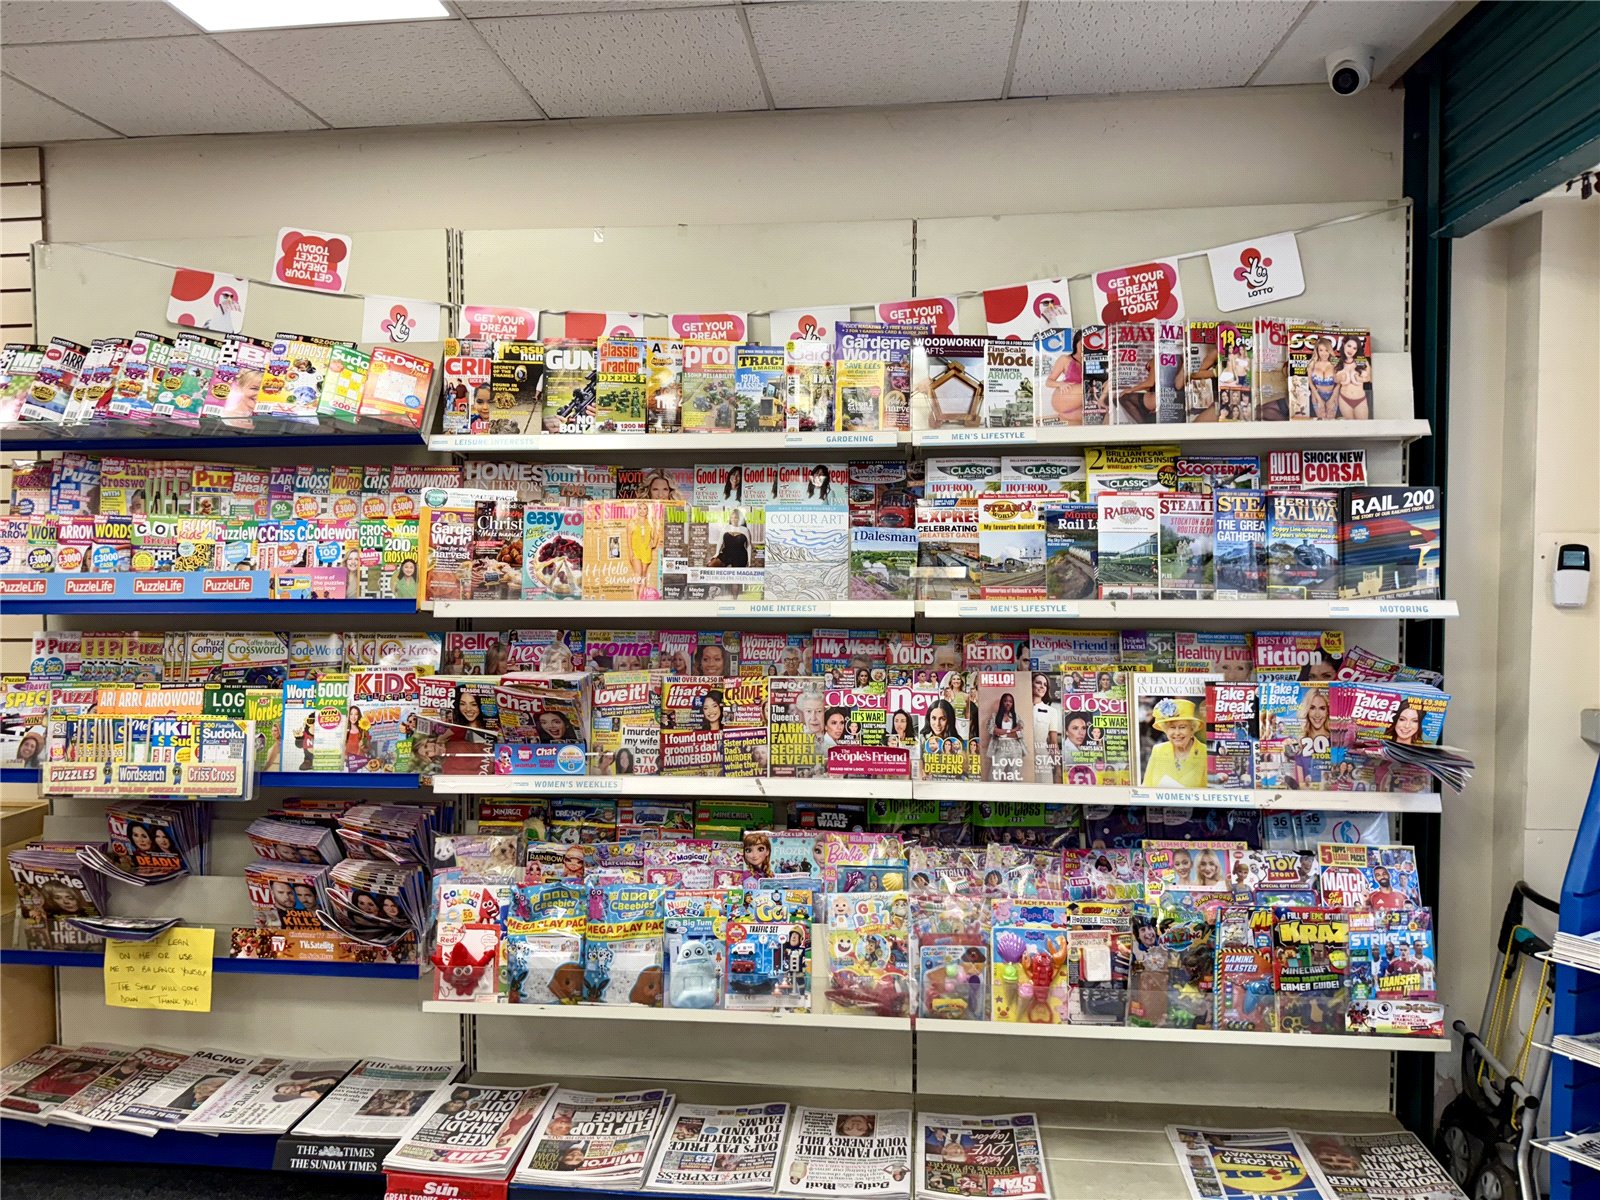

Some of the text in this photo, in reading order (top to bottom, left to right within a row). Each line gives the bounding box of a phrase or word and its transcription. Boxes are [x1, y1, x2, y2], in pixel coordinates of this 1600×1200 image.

[296, 242, 330, 256] TODAY
[294, 250, 328, 264] TICKET
[292, 260, 328, 274] DREAM
[285, 268, 334, 284] GET YOUR
[1108, 270, 1164, 289] GET YOUR
[1117, 284, 1158, 297] DREAM
[1248, 286, 1273, 298] LOTTO
[1118, 291, 1159, 307] TICKET
[890, 304, 943, 320] GET YOUR
[1120, 300, 1159, 316] TODAY
[473, 314, 525, 326] GET YOUR
[480, 324, 517, 334] DREAM
[682, 321, 734, 332] GET YOUR
[600, 343, 638, 358] Classic
[1160, 353, 1177, 366] 64
[600, 359, 640, 374] Tractor
[988, 371, 1022, 380] ARMOR
[952, 431, 1025, 440] MEN'S LIFESTYLE
[1106, 450, 1142, 458] BRILLIANT
[1304, 452, 1364, 464] SHOCK NEW
[1106, 456, 1149, 464] MAGAZINES
[1270, 452, 1300, 474] AUTO
[696, 468, 716, 484] Good
[1026, 466, 1068, 476] CLASSIC
[1304, 465, 1364, 482] CORSA
[1110, 478, 1148, 488] CLASSIC
[1351, 489, 1434, 516] RAIL 200
[770, 514, 844, 525] COLOUR ART
[1058, 519, 1087, 530] Rail
[1217, 520, 1238, 530] THE
[860, 531, 916, 543] Dalesman
[384, 538, 411, 551] 200
[67, 579, 251, 593] PuzzleLife PuzzleLife PuzzleLife
[750, 604, 817, 612] HOME INTEREST
[990, 604, 1067, 612] MEN'S LIFESTYLE
[1379, 605, 1429, 613] MOTORING
[742, 635, 786, 650] Woman's
[888, 646, 934, 664] Yours
[967, 644, 1013, 661] RETRO
[1177, 647, 1222, 661] Healthy
[1258, 648, 1322, 665] Fiction
[981, 674, 1015, 685] HELLO!
[420, 684, 448, 696] Take
[724, 686, 762, 701] CRIME
[1215, 686, 1246, 700] Take
[1269, 683, 1291, 694] Take
[420, 696, 454, 709] Break
[498, 693, 541, 713] Chat
[826, 693, 886, 708] Closer
[1269, 694, 1298, 705] Break
[1354, 692, 1389, 710] Take
[1215, 700, 1254, 712] Break
[772, 713, 800, 723] Queen's
[865, 712, 884, 721] WAR!
[1351, 706, 1397, 722] Break
[202, 728, 244, 739] Sudoku
[772, 723, 803, 733] DARK
[640, 738, 658, 746] wife
[668, 732, 696, 744] found
[772, 733, 815, 743] FAMILY
[643, 756, 655, 764] TV
[664, 753, 712, 766] MURDERED
[830, 751, 907, 764] People's Friend
[943, 753, 964, 764] FEUD
[992, 756, 1024, 768] Love
[51, 766, 235, 782] PUZZLES Wordsearch Criss Cross
[633, 766, 656, 774] STAR
[924, 764, 963, 774] DEEPENS
[534, 780, 618, 788] WOMEN'S WEEKLIES
[1155, 793, 1250, 802] WOMEN'S LIFESTYLE
[818, 812, 848, 820] STAR
[818, 820, 848, 828] WARS
[1286, 912, 1301, 920] FULL
[1310, 912, 1323, 920] EPIC
[616, 922, 646, 933] PLAY
[696, 918, 712, 926] Tum
[768, 926, 778, 934] SET
[167, 938, 189, 946] LEAN
[119, 952, 130, 960] ON
[139, 952, 151, 960] ME
[158, 952, 170, 960] OR
[1225, 955, 1254, 964] GAMING
[1224, 964, 1258, 972] BLASTER
[1280, 982, 1312, 992] GAMER
[195, 1050, 246, 1066] RACING
[415, 1064, 452, 1072] TIMES
[485, 1100, 515, 1110] OUT
[594, 1108, 657, 1122] FARAGE
[738, 1116, 783, 1126] FARMS
[722, 1125, 763, 1135] WIND
[447, 1134, 490, 1146] KEEP
[700, 1133, 751, 1144] SWITCH
[826, 1137, 874, 1148] ENERGY
[297, 1145, 374, 1158] THE TIMES
[668, 1141, 706, 1152] PRICE
[828, 1145, 870, 1157] FARMS
[968, 1144, 1014, 1156] LOVE
[290, 1158, 377, 1172] THE SUNDAY TIMES
[656, 1172, 720, 1182] EXPRESS
